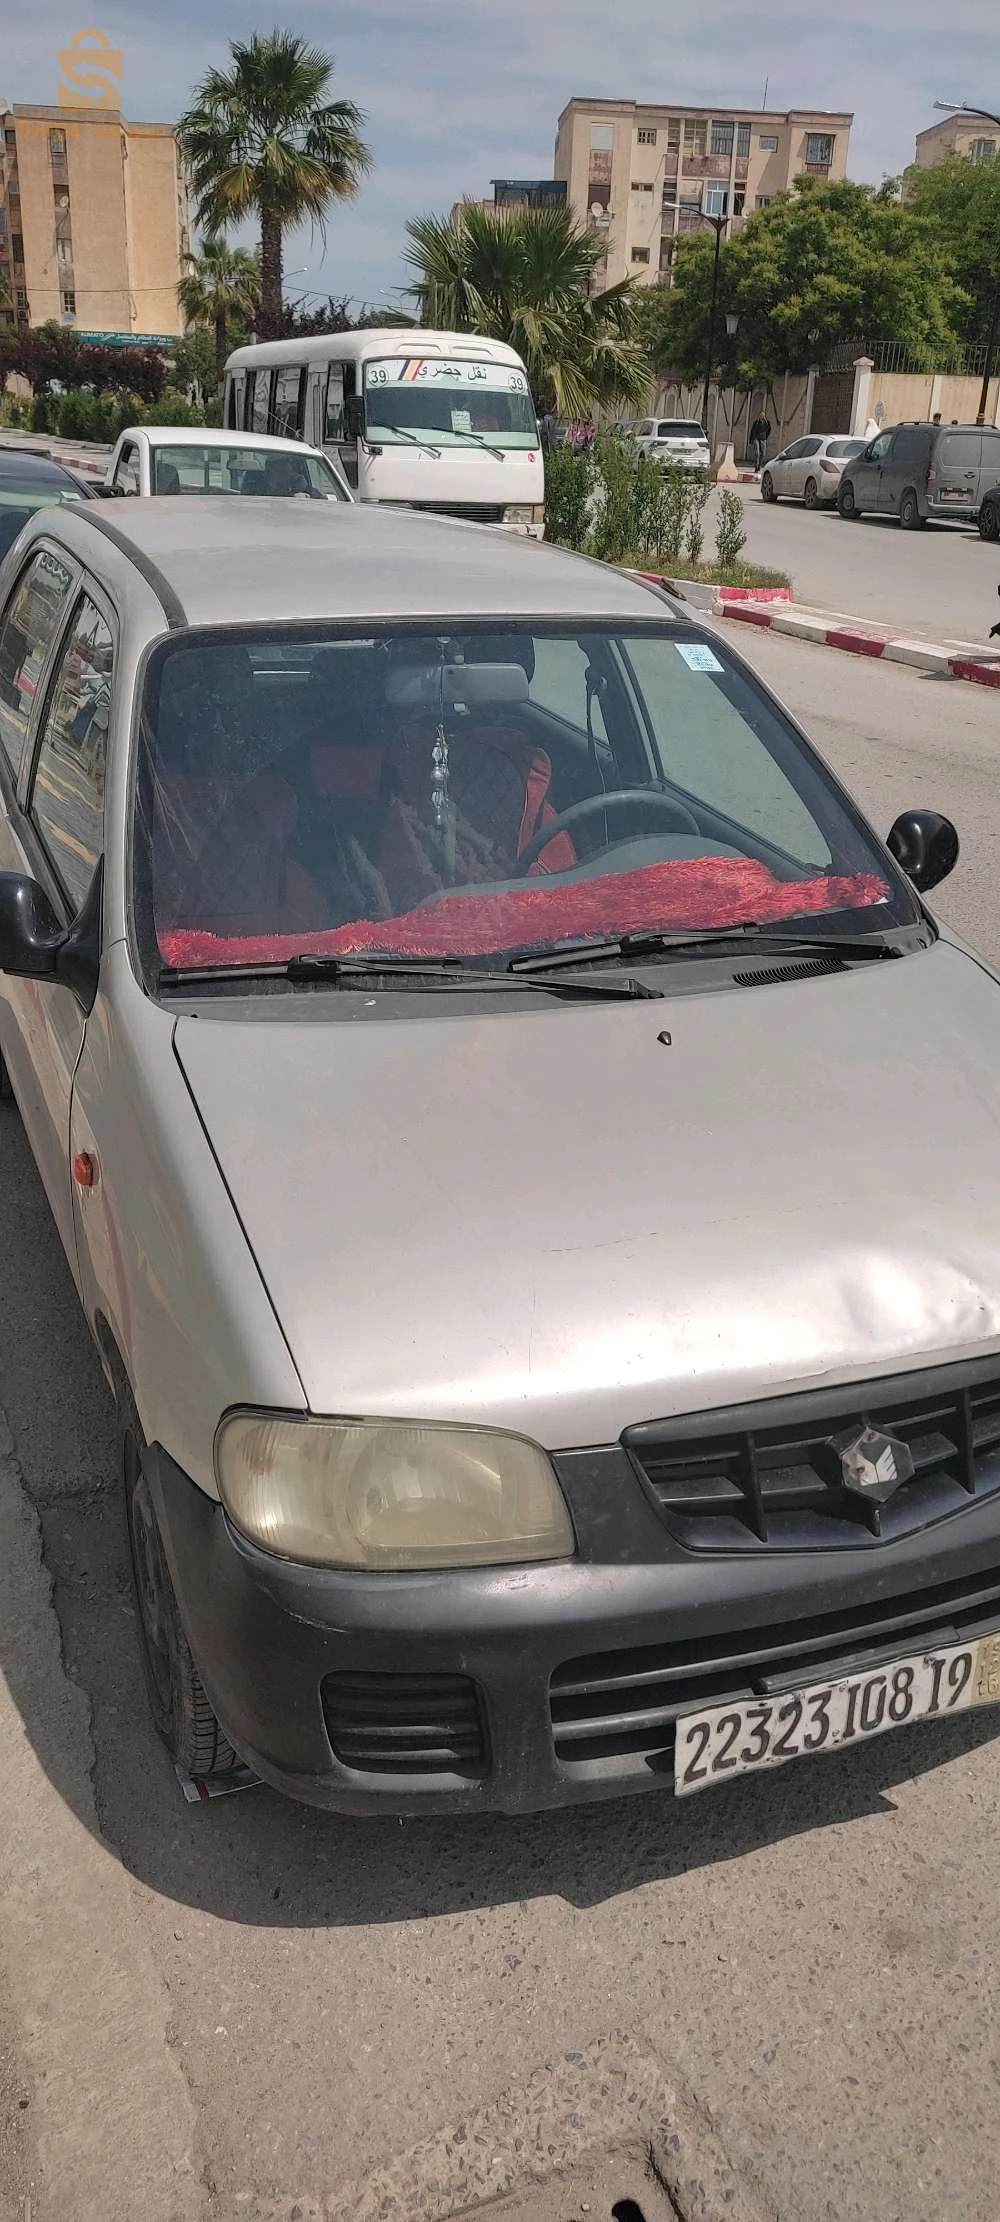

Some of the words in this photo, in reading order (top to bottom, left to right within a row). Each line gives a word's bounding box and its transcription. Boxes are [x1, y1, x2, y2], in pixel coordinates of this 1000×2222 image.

[370, 370, 387, 384] 39
[468, 366, 487, 381] نقل
[509, 376, 524, 390] 39
[683, 1690, 833, 1785] 22323
[843, 1667, 914, 1738] 108
[927, 1653, 973, 1712] 19
